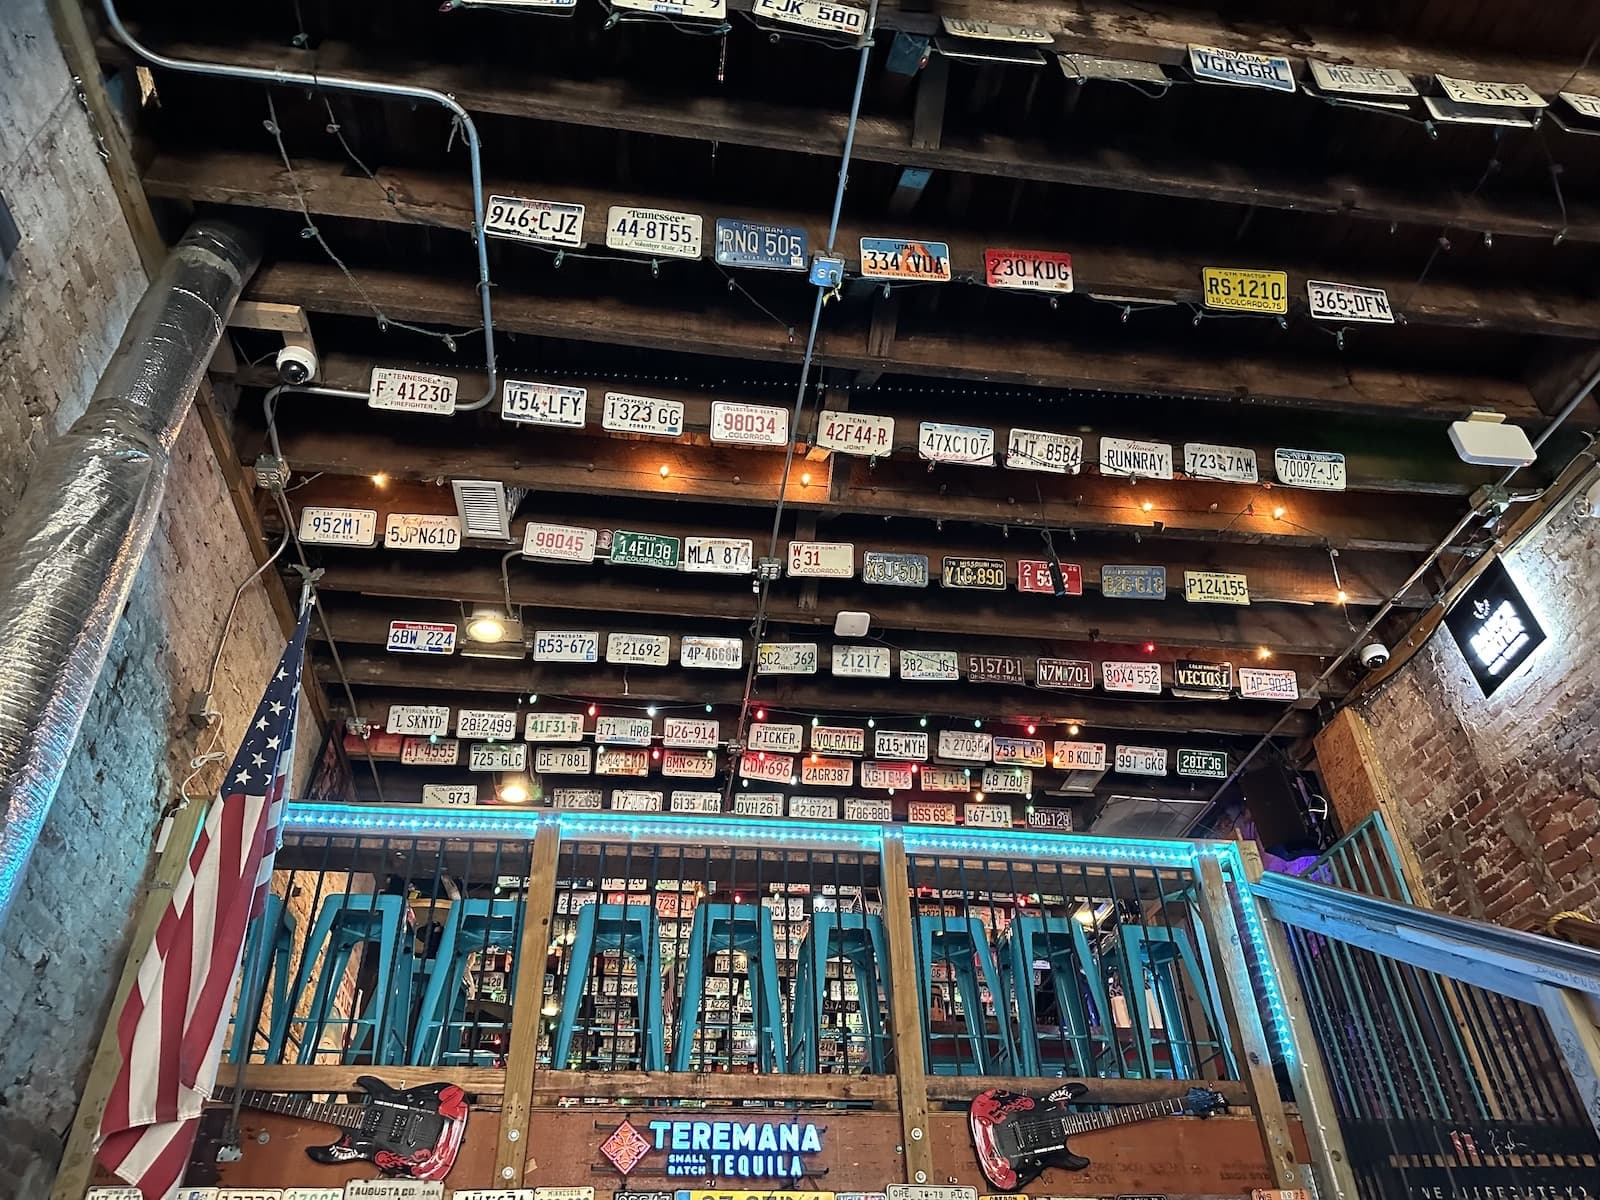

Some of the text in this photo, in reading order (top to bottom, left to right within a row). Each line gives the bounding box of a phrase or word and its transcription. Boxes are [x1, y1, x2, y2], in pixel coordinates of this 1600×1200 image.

[817, 6, 860, 26] 580
[1197, 53, 1288, 83] VGASGRL
[1474, 86, 1532, 102] 5143
[630, 209, 681, 223] Tennessee
[742, 222, 783, 233] MICHIGAN
[721, 228, 802, 257] RNQ 505
[894, 243, 917, 252] UTAH
[867, 251, 899, 271] 334
[991, 258, 1070, 281] 230 KDG
[397, 382, 450, 404] 41230
[390, 400, 433, 410] FIREFIGHTER
[723, 412, 776, 434] 98034
[847, 416, 867, 425] TENN
[1106, 449, 1165, 471] RUNNRAY
[535, 531, 584, 552] 98045
[804, 551, 820, 566] 31
[1036, 569, 1070, 588] 532
[426, 631, 453, 646] 224
[537, 637, 595, 655] R53-672
[622, 642, 661, 658] 21692
[793, 651, 814, 666] 369
[840, 653, 881, 669] 21217
[902, 657, 923, 672] 382
[1137, 669, 1159, 685] 552
[406, 715, 442, 730] SKNYD
[461, 717, 512, 734] 28 2499
[756, 731, 795, 745] PICKER
[817, 733, 861, 749] VOLRATH
[561, 754, 588, 768] 7881
[695, 757, 713, 771] 735
[1068, 750, 1073, 764] B
[1076, 750, 1102, 765] KOLD
[448, 792, 470, 804] 973
[759, 802, 779, 815] 261
[648, 1120, 822, 1153] TEREMANA
[668, 1153, 706, 1164] SMALL
[710, 1154, 803, 1177] TEQUILA
[668, 1165, 706, 1176] BATCH
[355, 1187, 399, 1196] AUGUSTA
